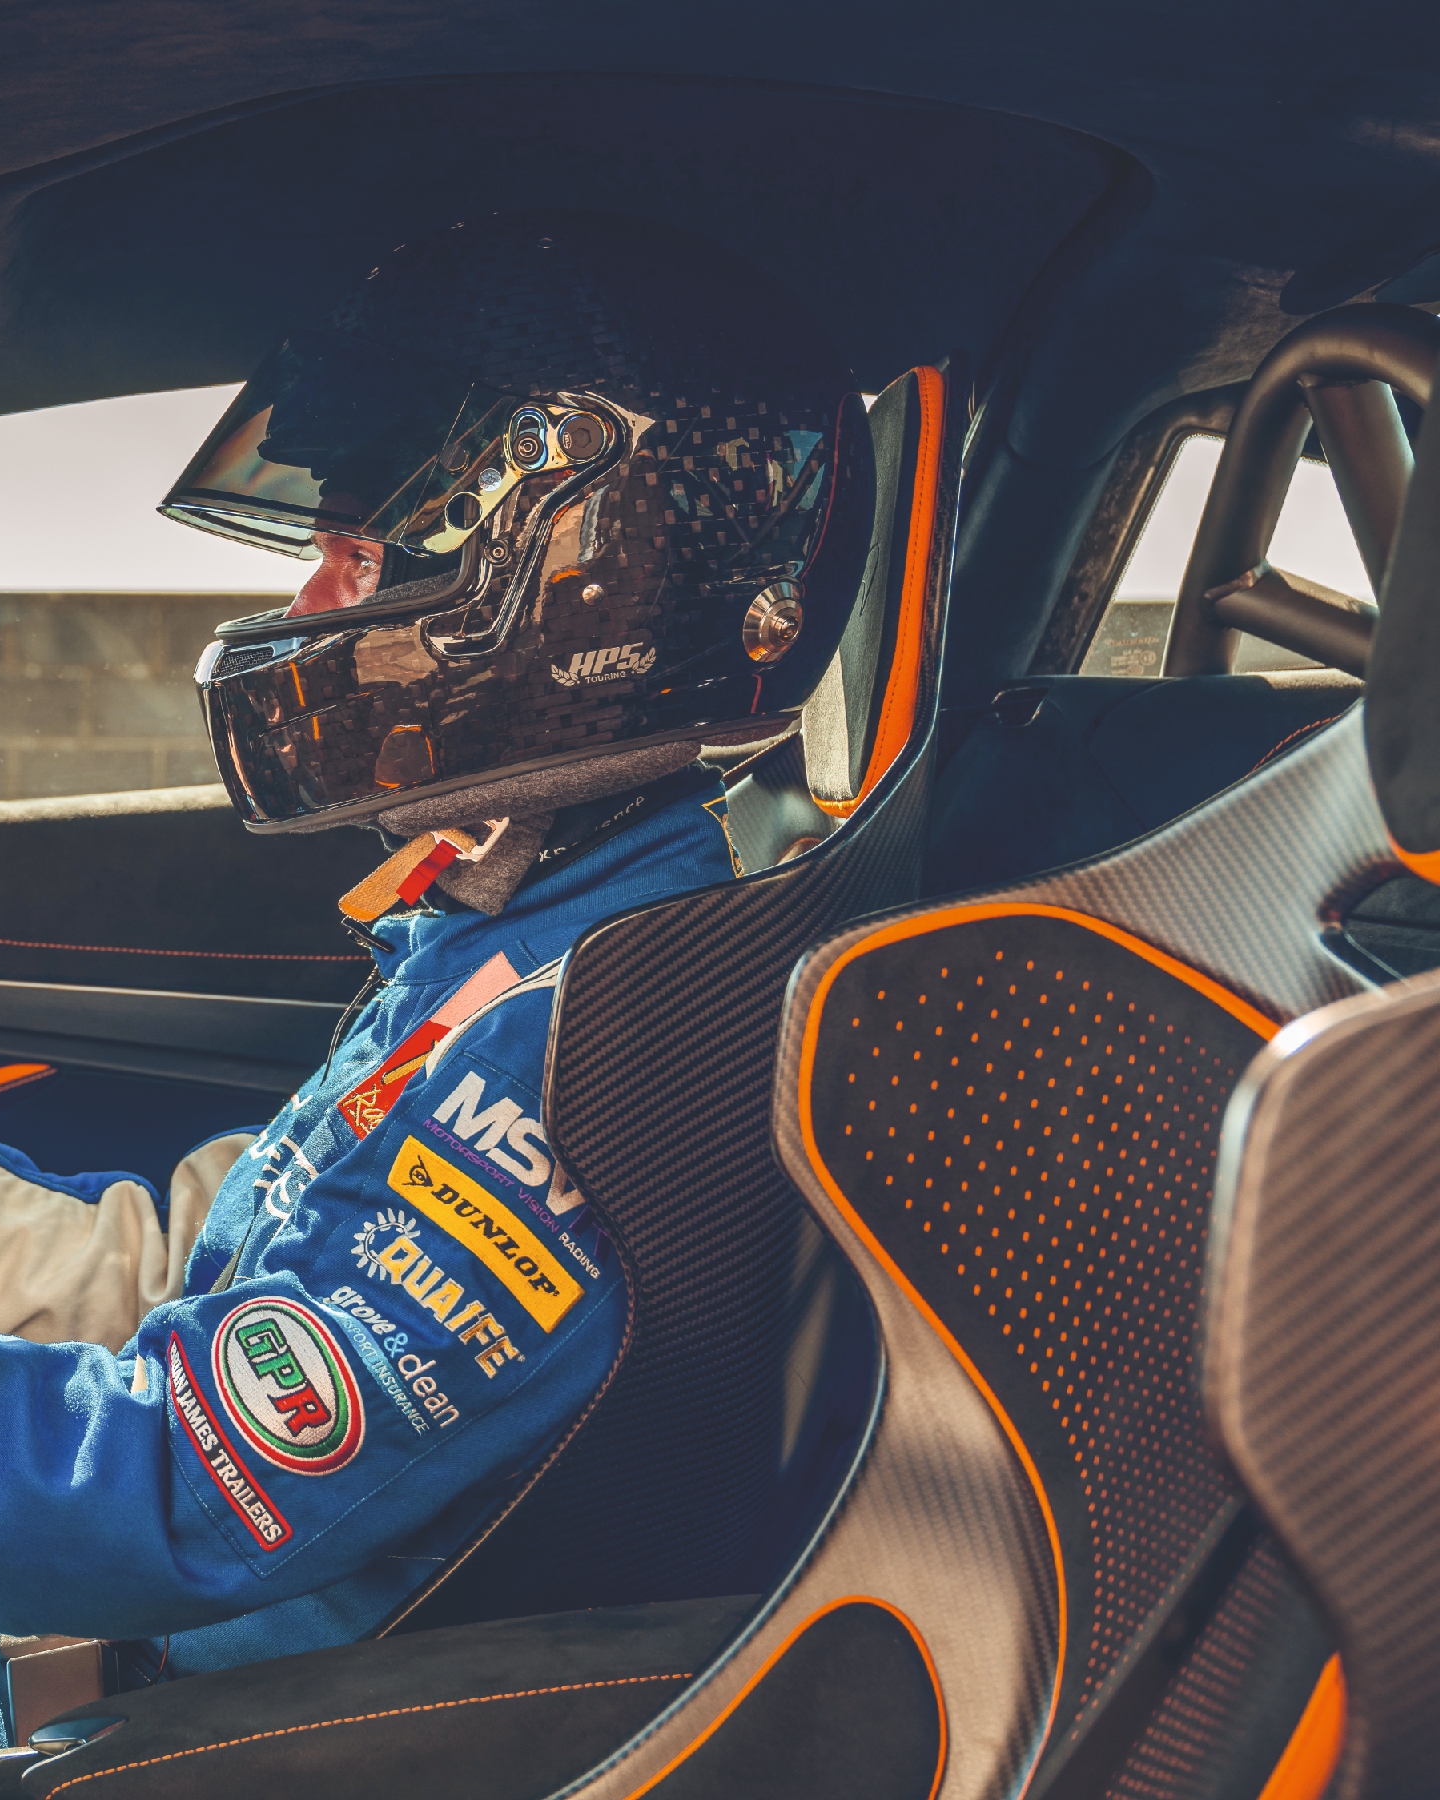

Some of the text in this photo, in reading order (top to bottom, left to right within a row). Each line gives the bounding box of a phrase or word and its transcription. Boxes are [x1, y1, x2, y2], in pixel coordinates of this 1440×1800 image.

[584, 671, 627, 684] TOURING
[422, 1118, 516, 1188] MOTORSPORT
[517, 1186, 560, 1234] VISION
[431, 1183, 557, 1295] DUNLOP
[323, 1285, 460, 1429] grove & dean
[376, 1235, 519, 1379] QUAIFE
[235, 1318, 332, 1438] GPR
[371, 1359, 430, 1438] INSURANCE
[176, 1388, 219, 1451] JAMES
[210, 1448, 283, 1543] TRAILERS
